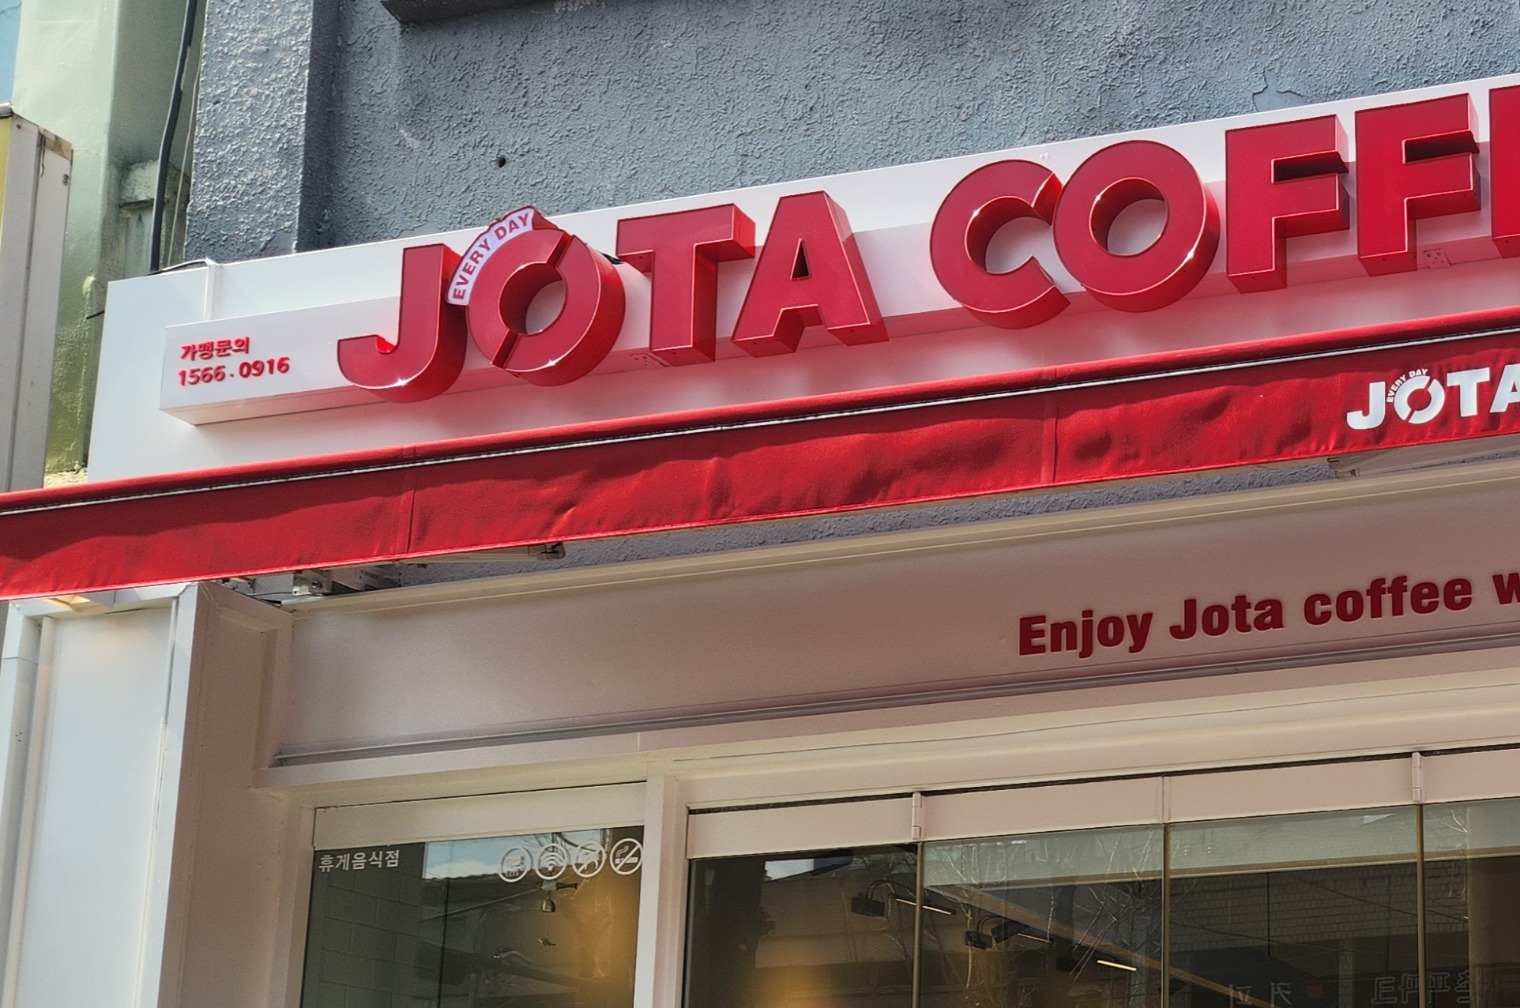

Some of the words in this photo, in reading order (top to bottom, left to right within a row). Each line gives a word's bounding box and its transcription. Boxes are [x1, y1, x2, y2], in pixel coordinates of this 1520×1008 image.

[453, 238, 491, 300] EVERY
[494, 213, 530, 241] DAY
[337, 190, 889, 402] JOTA
[180, 336, 250, 361] 가맹문의
[1386, 375, 1406, 403] EVERY
[1409, 368, 1428, 378] DAY
[1018, 610, 1153, 659] Enjoy
[1169, 598, 1284, 640] Jota
[1303, 575, 1473, 626] coffee
[318, 850, 401, 873] 휴게음식점
